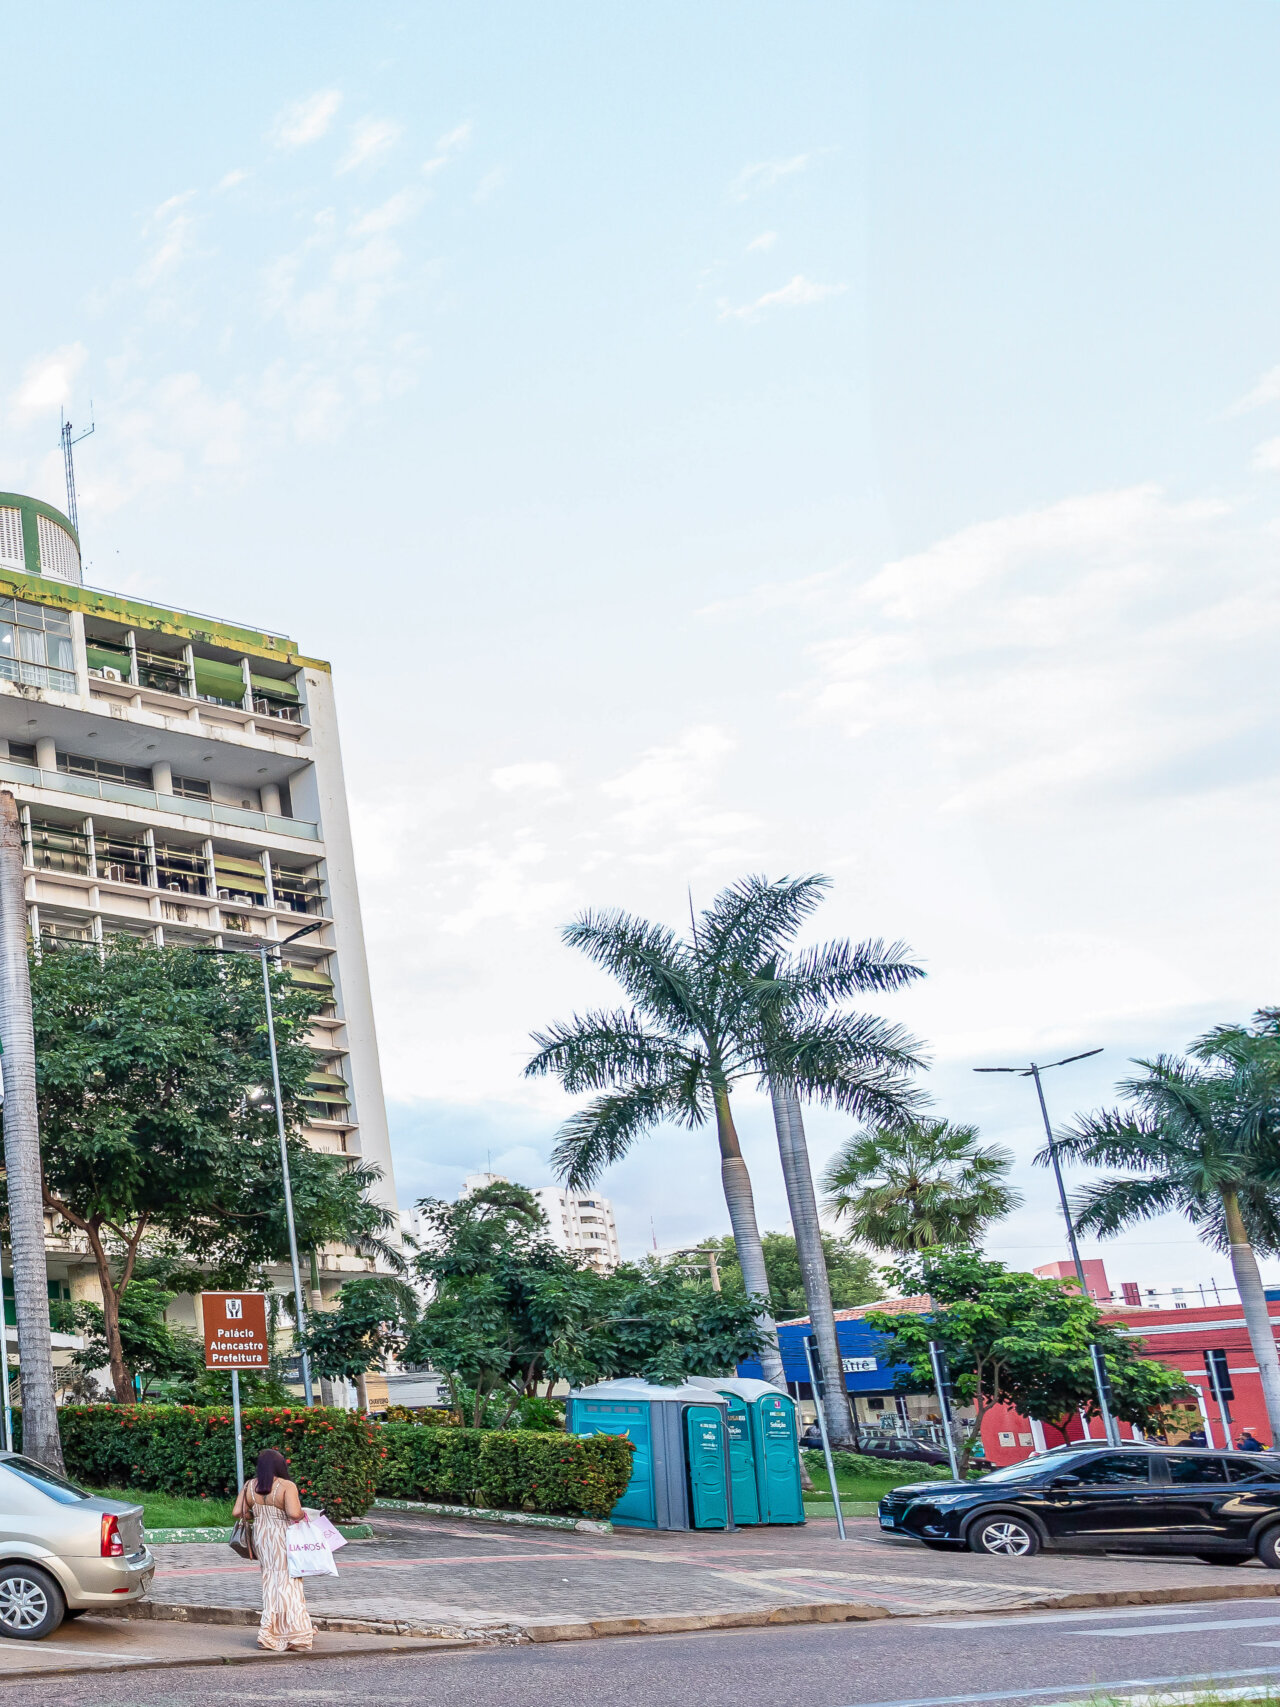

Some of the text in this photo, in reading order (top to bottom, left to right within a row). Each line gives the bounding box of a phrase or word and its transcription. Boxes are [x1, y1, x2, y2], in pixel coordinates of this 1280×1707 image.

[217, 1328, 254, 1338] Palácio
[210, 1341, 264, 1351] Alencastro
[212, 1353, 262, 1363] Prefeitura
